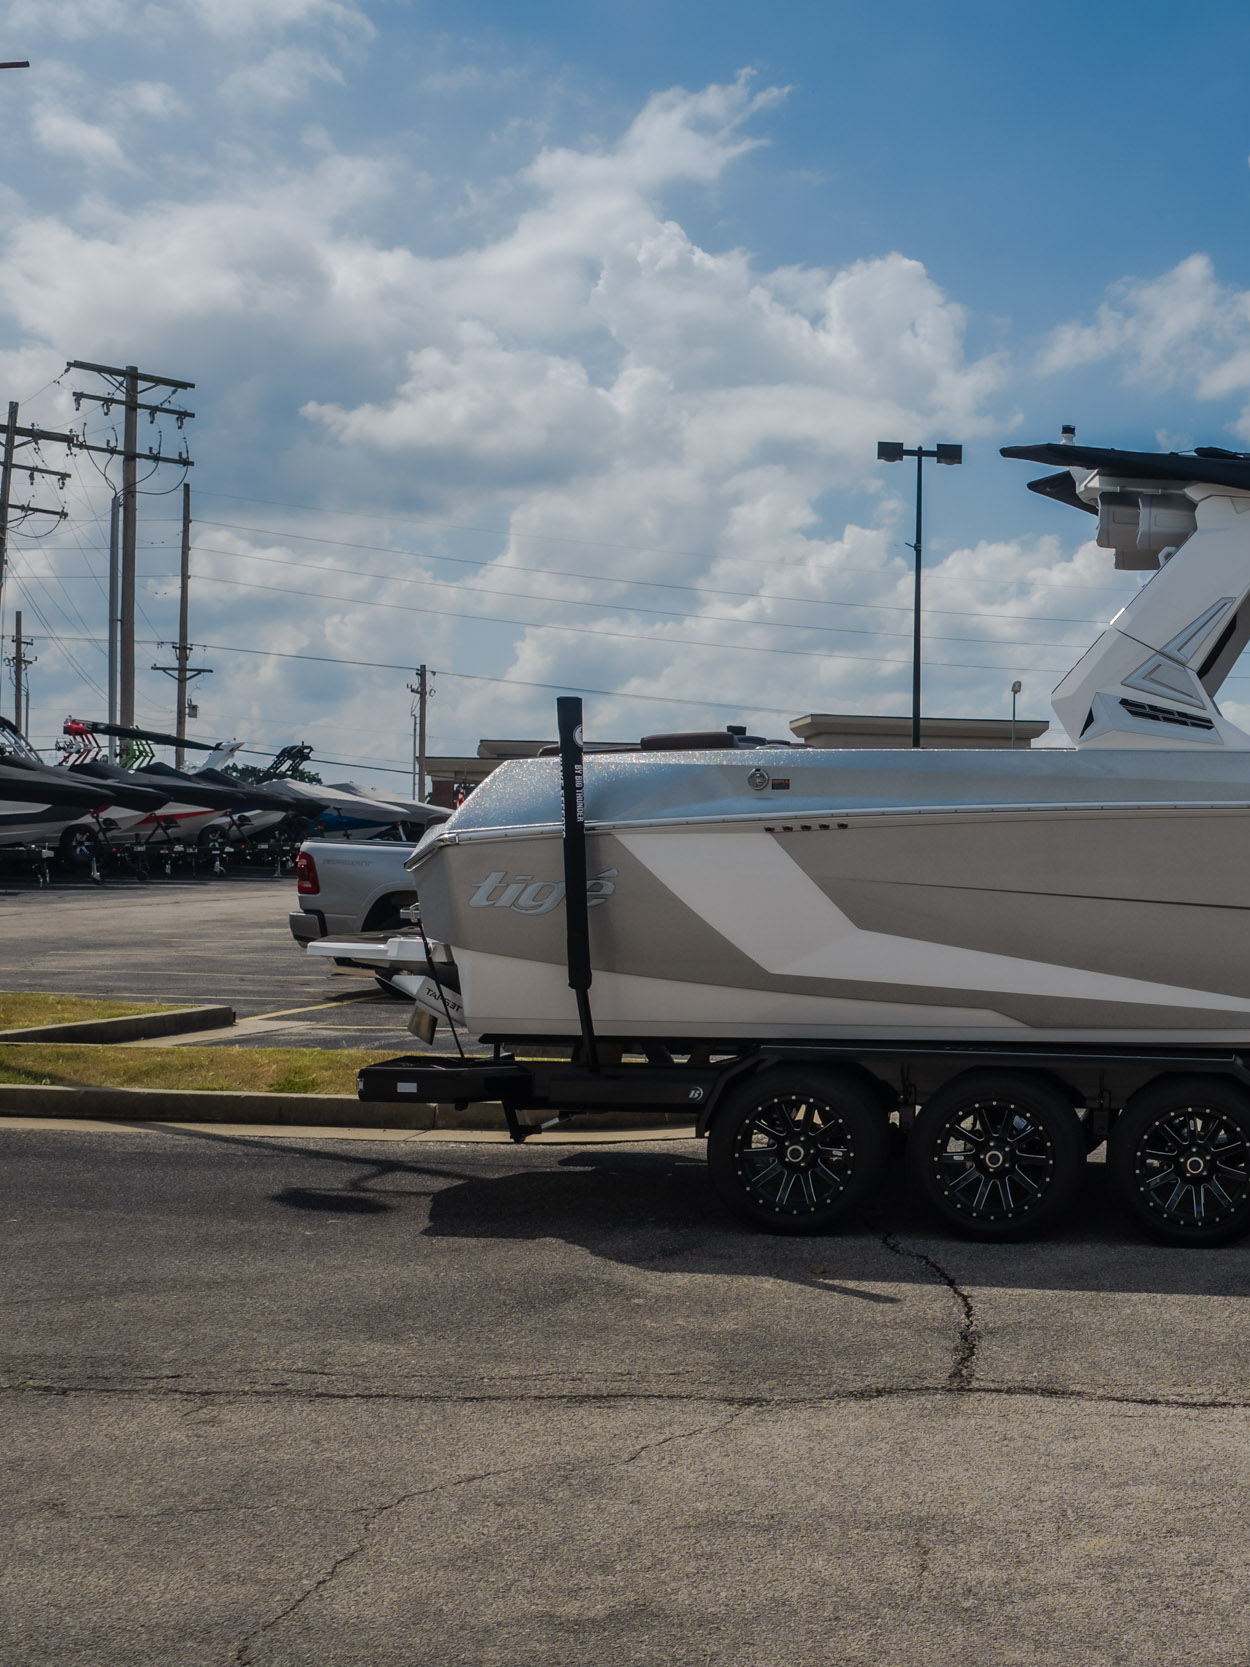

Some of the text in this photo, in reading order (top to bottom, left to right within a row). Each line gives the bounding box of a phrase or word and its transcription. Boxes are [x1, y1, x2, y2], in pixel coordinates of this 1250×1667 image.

[574, 764, 584, 822] BY BIG THUNDER
